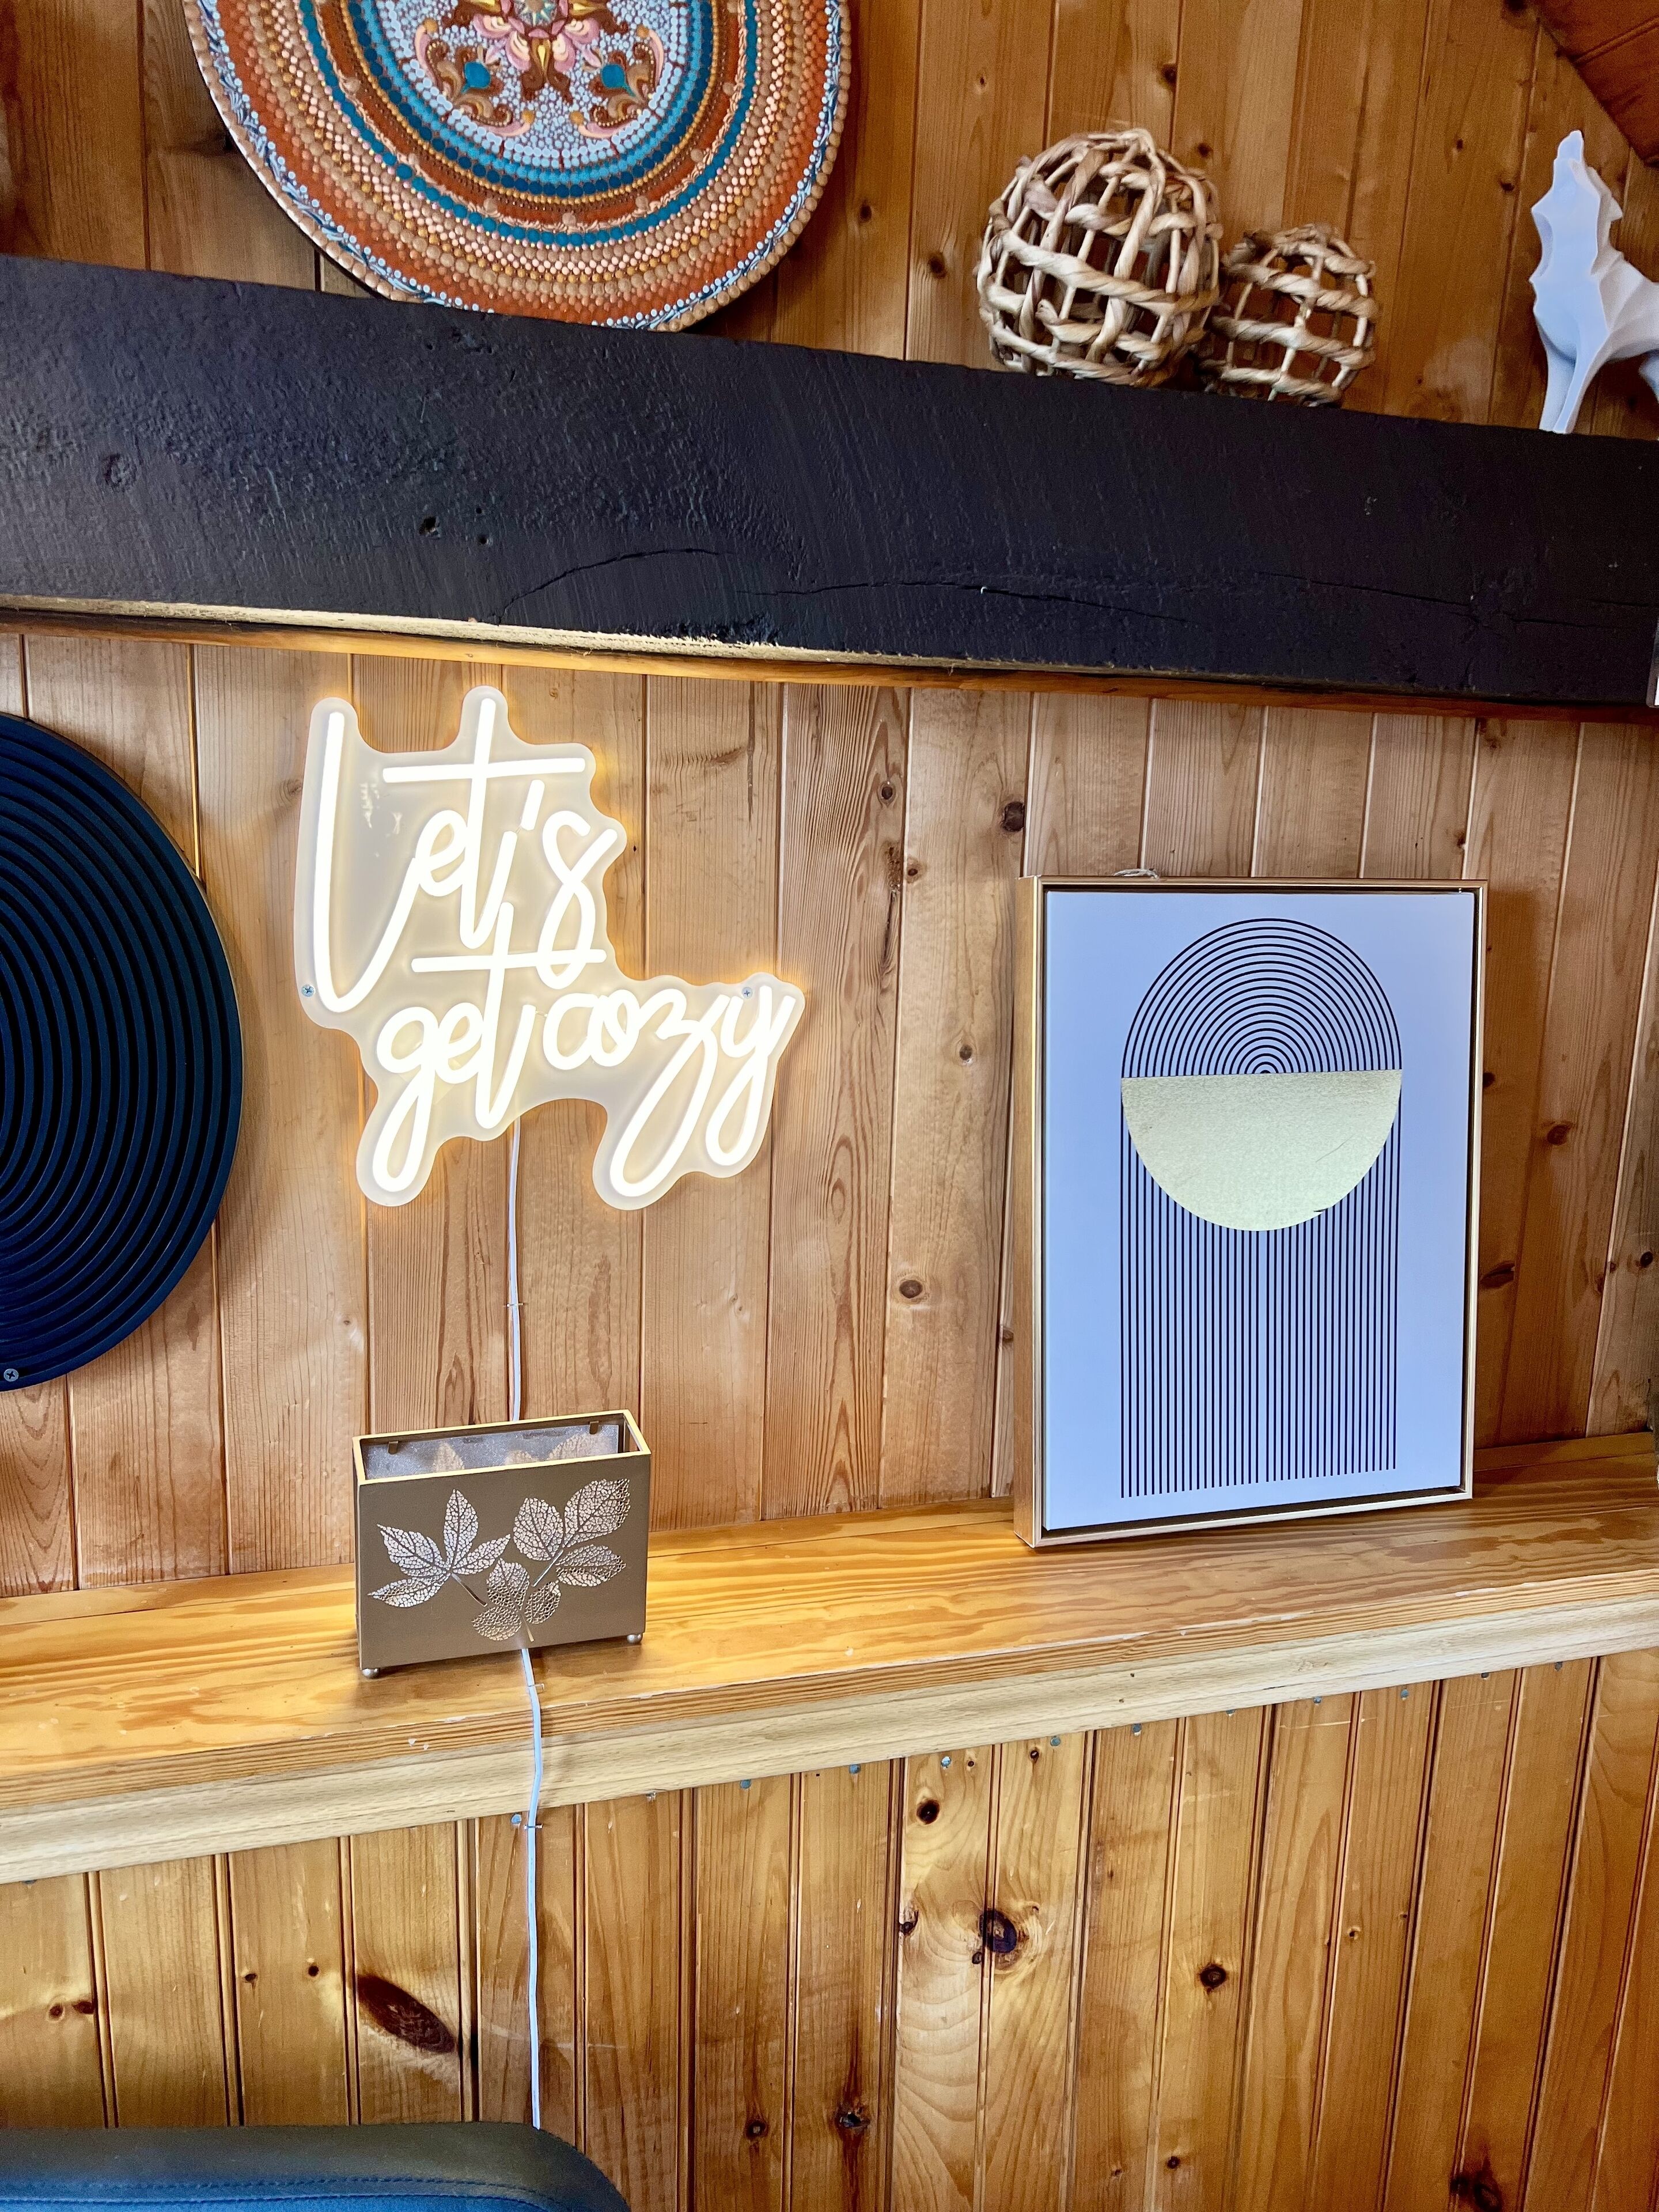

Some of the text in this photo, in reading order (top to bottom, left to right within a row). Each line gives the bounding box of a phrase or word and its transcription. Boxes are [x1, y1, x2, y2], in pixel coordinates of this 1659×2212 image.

[313, 698, 618, 1012] Let's
[372, 902, 796, 1197] get cozy
